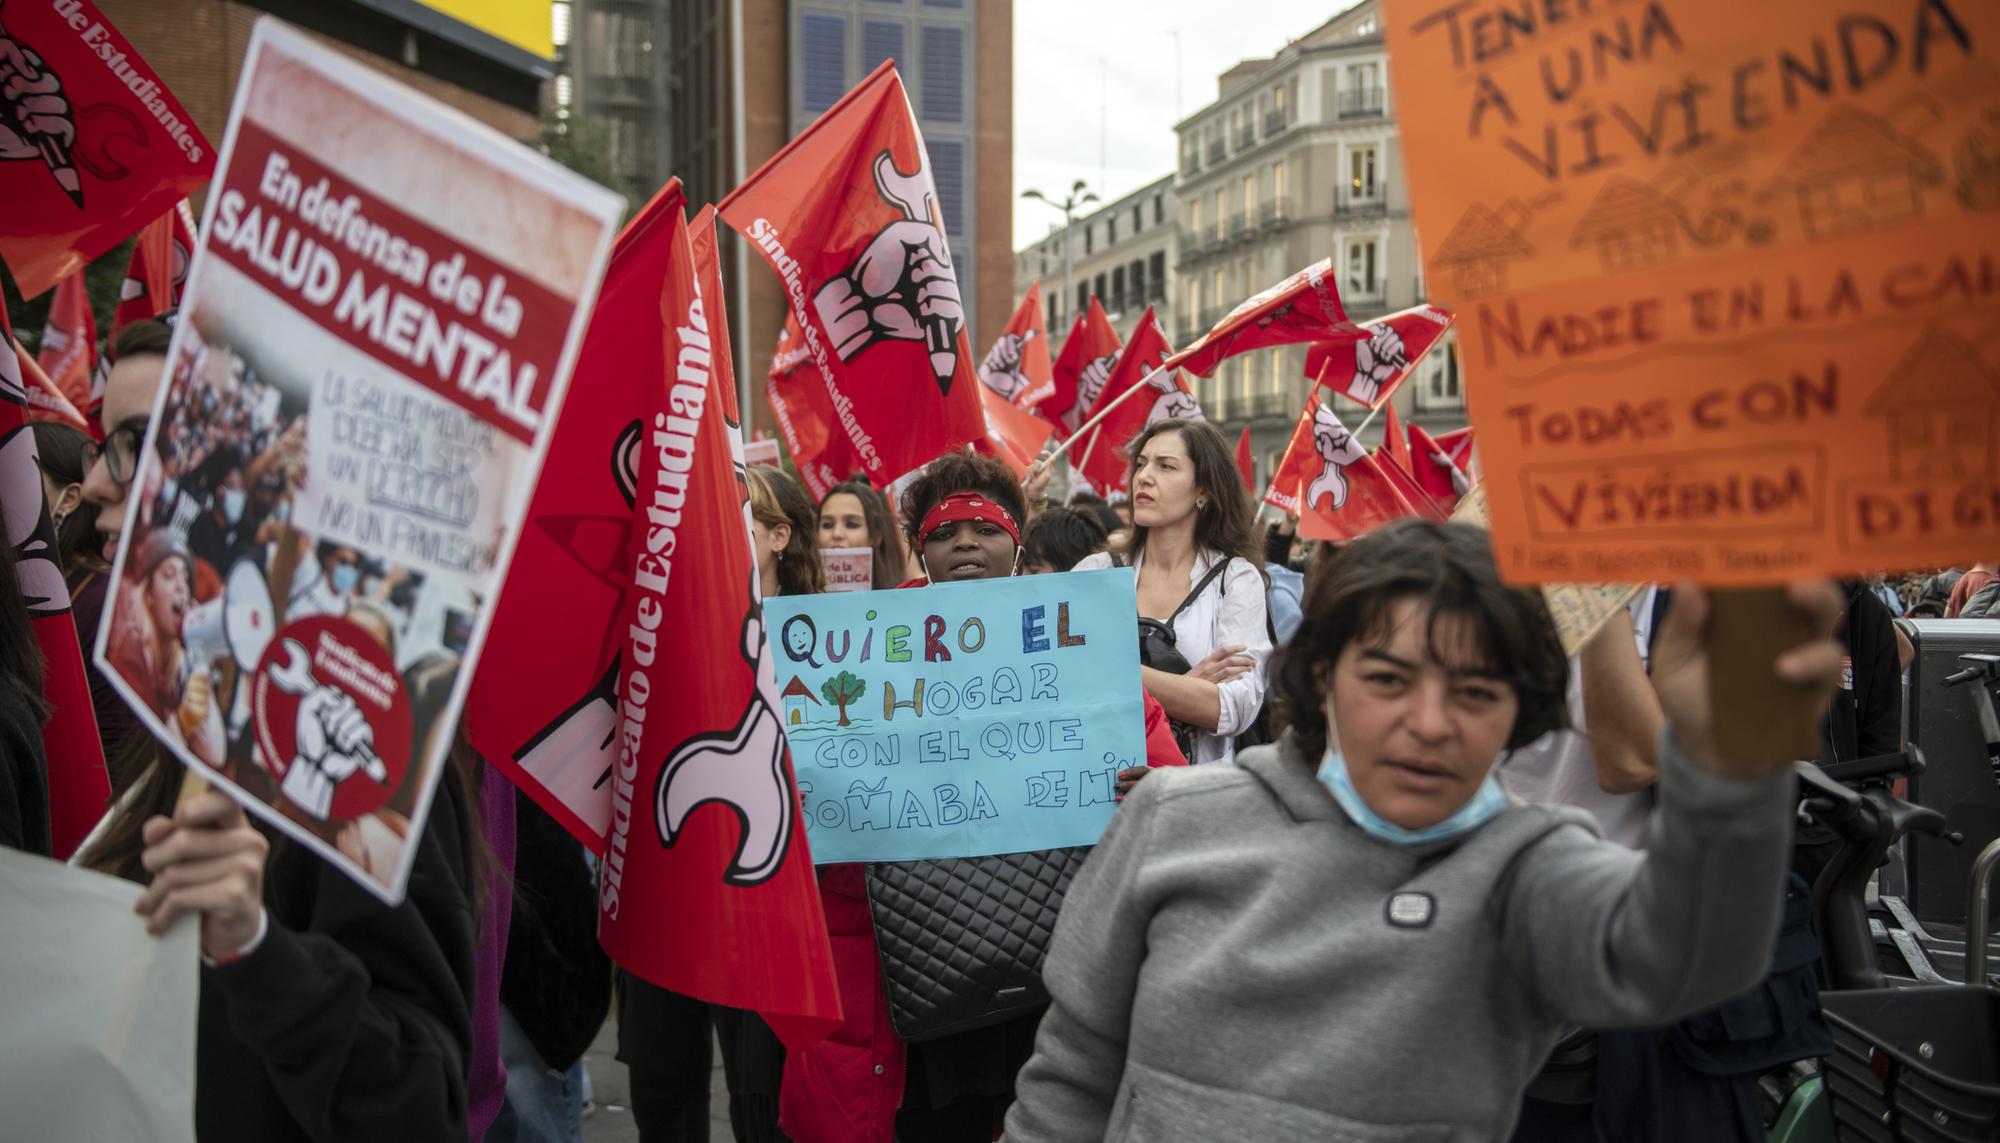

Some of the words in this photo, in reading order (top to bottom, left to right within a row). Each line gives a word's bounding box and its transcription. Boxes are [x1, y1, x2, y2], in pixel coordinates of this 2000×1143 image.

[53, 0, 89, 31] de
[80, 22, 204, 164] Estudiantes
[1468, 74, 1519, 138] A
[1540, 1, 1685, 101] UNA
[260, 151, 301, 212] En
[299, 177, 429, 288] defensa
[427, 252, 484, 316] de
[480, 273, 524, 339] la
[213, 188, 341, 306] SALUD
[333, 268, 540, 430] MENTAL
[1477, 298, 1662, 369] NADIE
[1688, 278, 1763, 332] EN
[1787, 268, 1863, 321] LA
[1880, 252, 2000, 309] CA
[805, 324, 821, 356] de
[816, 347, 883, 472] Estudiantes
[1504, 398, 1674, 447] TODAS
[1689, 362, 1839, 430] CON
[1535, 464, 1809, 529] VIVIENDA
[1857, 480, 2000, 537] DIG
[1022, 602, 1086, 654] EL
[883, 662, 1059, 721] HOGAR
[602, 670, 650, 920] Sindicato
[629, 596, 663, 667] de
[815, 733, 899, 768] CON
[919, 731, 970, 763] EL
[980, 719, 1084, 761] QUE
[1024, 770, 1069, 808] DE
